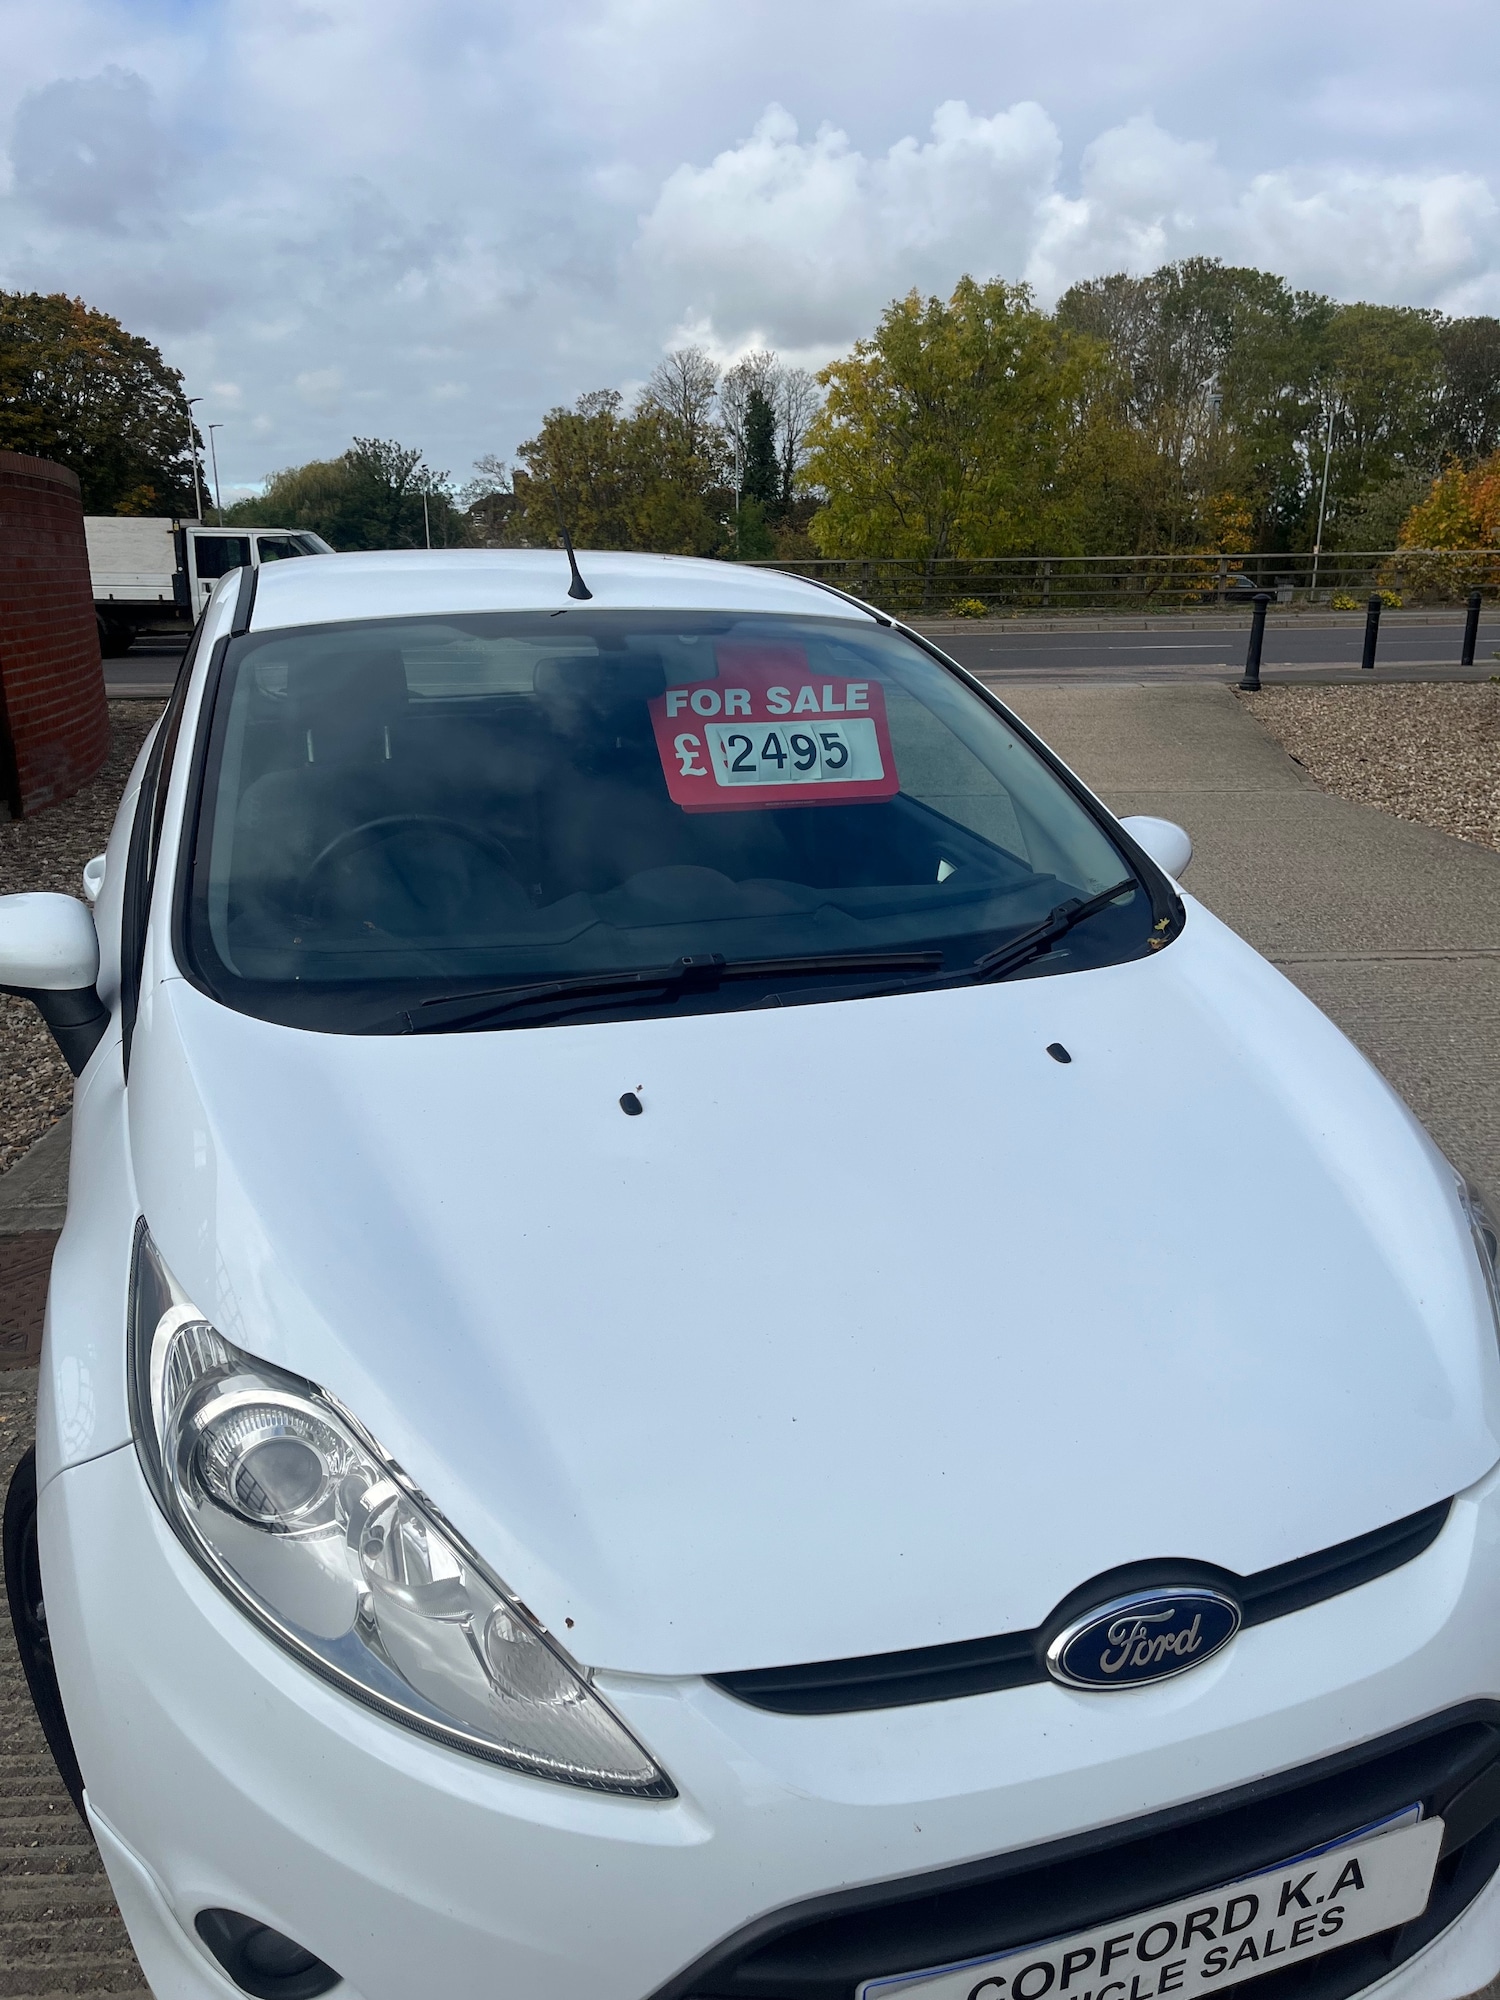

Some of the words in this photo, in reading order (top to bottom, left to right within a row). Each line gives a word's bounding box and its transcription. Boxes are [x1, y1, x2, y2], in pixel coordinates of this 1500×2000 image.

[665, 688, 752, 718] FOR
[765, 683, 870, 714] SALE
[673, 733, 708, 777] £
[728, 732, 849, 773] 2495
[1100, 1608, 1202, 1674] Ford
[966, 1893, 1259, 2000] COPFORD
[1277, 1858, 1365, 1917] K.A
[1200, 1905, 1346, 1978] SALES
